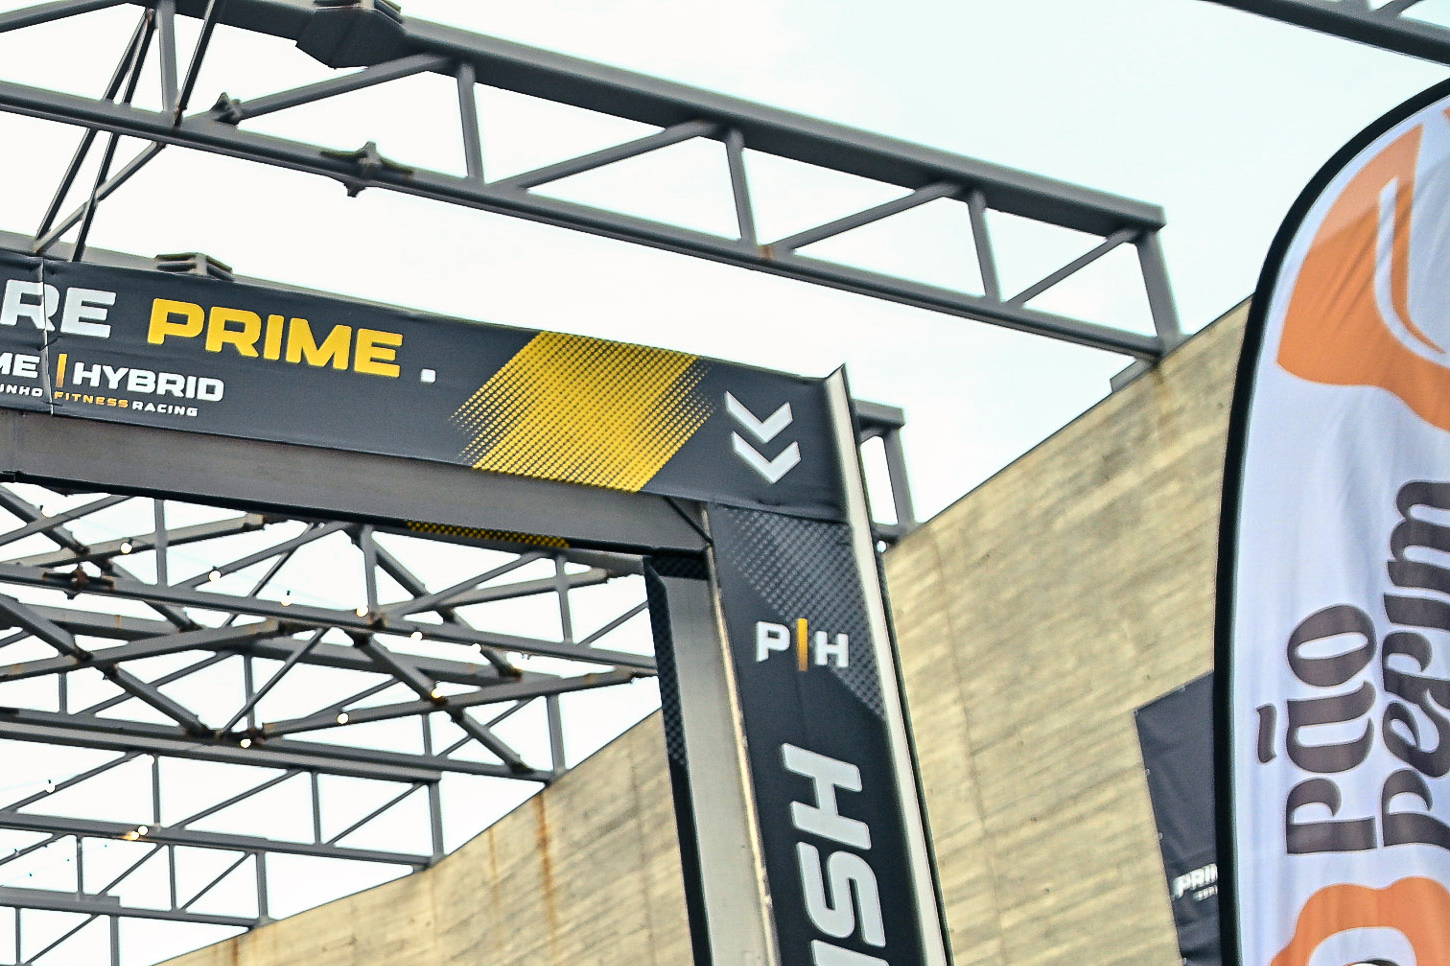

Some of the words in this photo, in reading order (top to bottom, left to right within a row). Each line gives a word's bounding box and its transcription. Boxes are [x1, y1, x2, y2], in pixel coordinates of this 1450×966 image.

[72, 362, 225, 403] HYBRID
[54, 390, 129, 408] FITNESS
[132, 400, 199, 417] RACING
